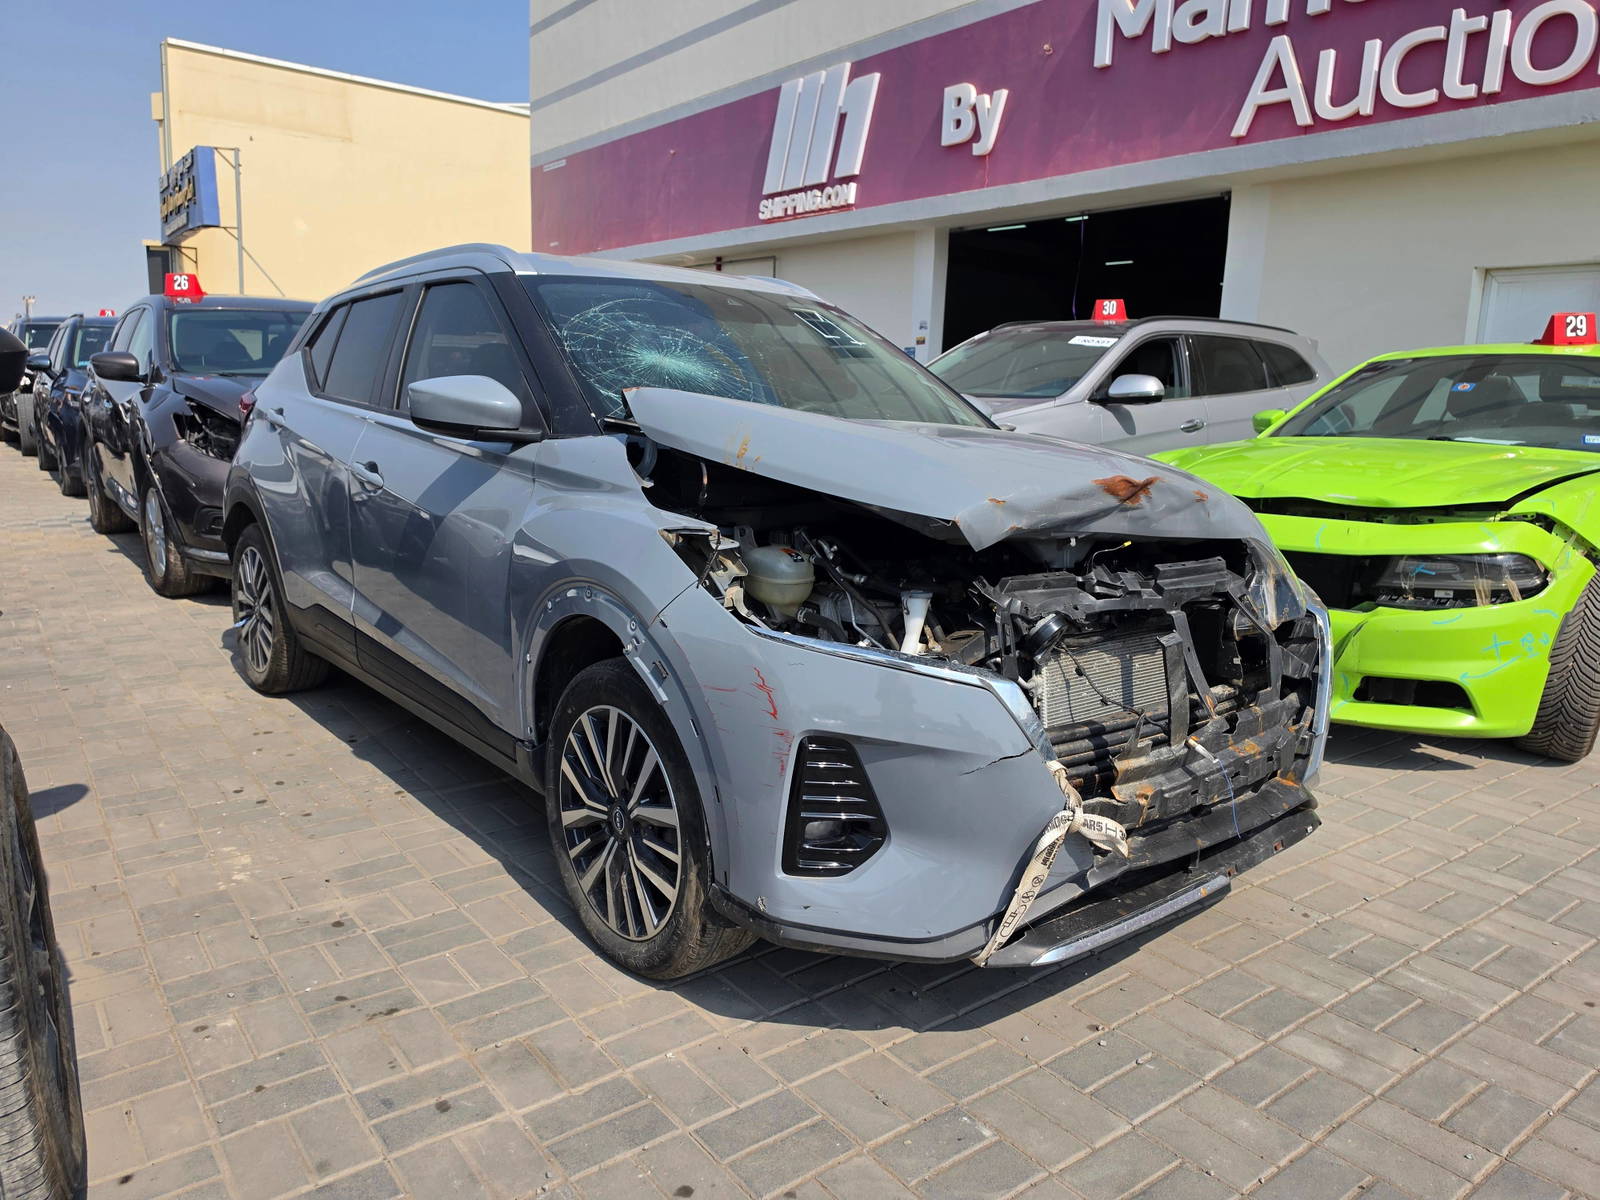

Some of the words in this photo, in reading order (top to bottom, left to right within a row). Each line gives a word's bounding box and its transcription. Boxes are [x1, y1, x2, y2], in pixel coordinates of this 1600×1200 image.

[1230, 0, 1600, 138] Auctio
[941, 82, 1008, 156] By
[758, 182, 857, 219] SHIPPING.COM
[173, 275, 188, 290] 26
[1102, 300, 1117, 315] 30
[1566, 315, 1587, 337] 29
